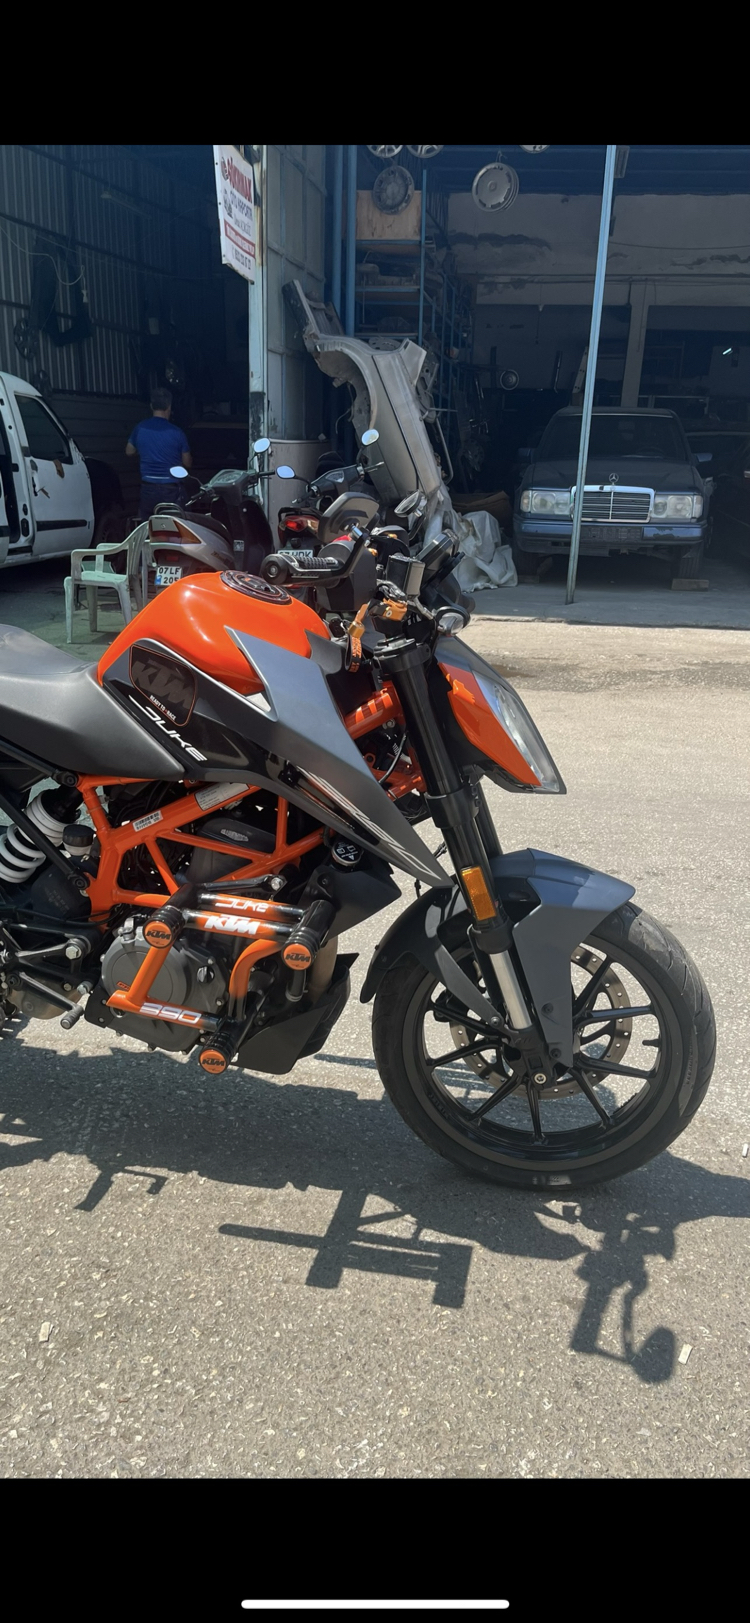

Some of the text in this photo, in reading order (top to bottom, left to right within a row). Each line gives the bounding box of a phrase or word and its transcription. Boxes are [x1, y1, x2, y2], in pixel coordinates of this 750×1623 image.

[158, 567, 180, 575] 07 LF
[131, 659, 193, 710] KTM
[204, 913, 261, 935] KTM
[145, 929, 172, 940] KTM
[285, 952, 311, 963] KTM
[140, 1002, 202, 1025] 390
[202, 1057, 225, 1067] KTM
